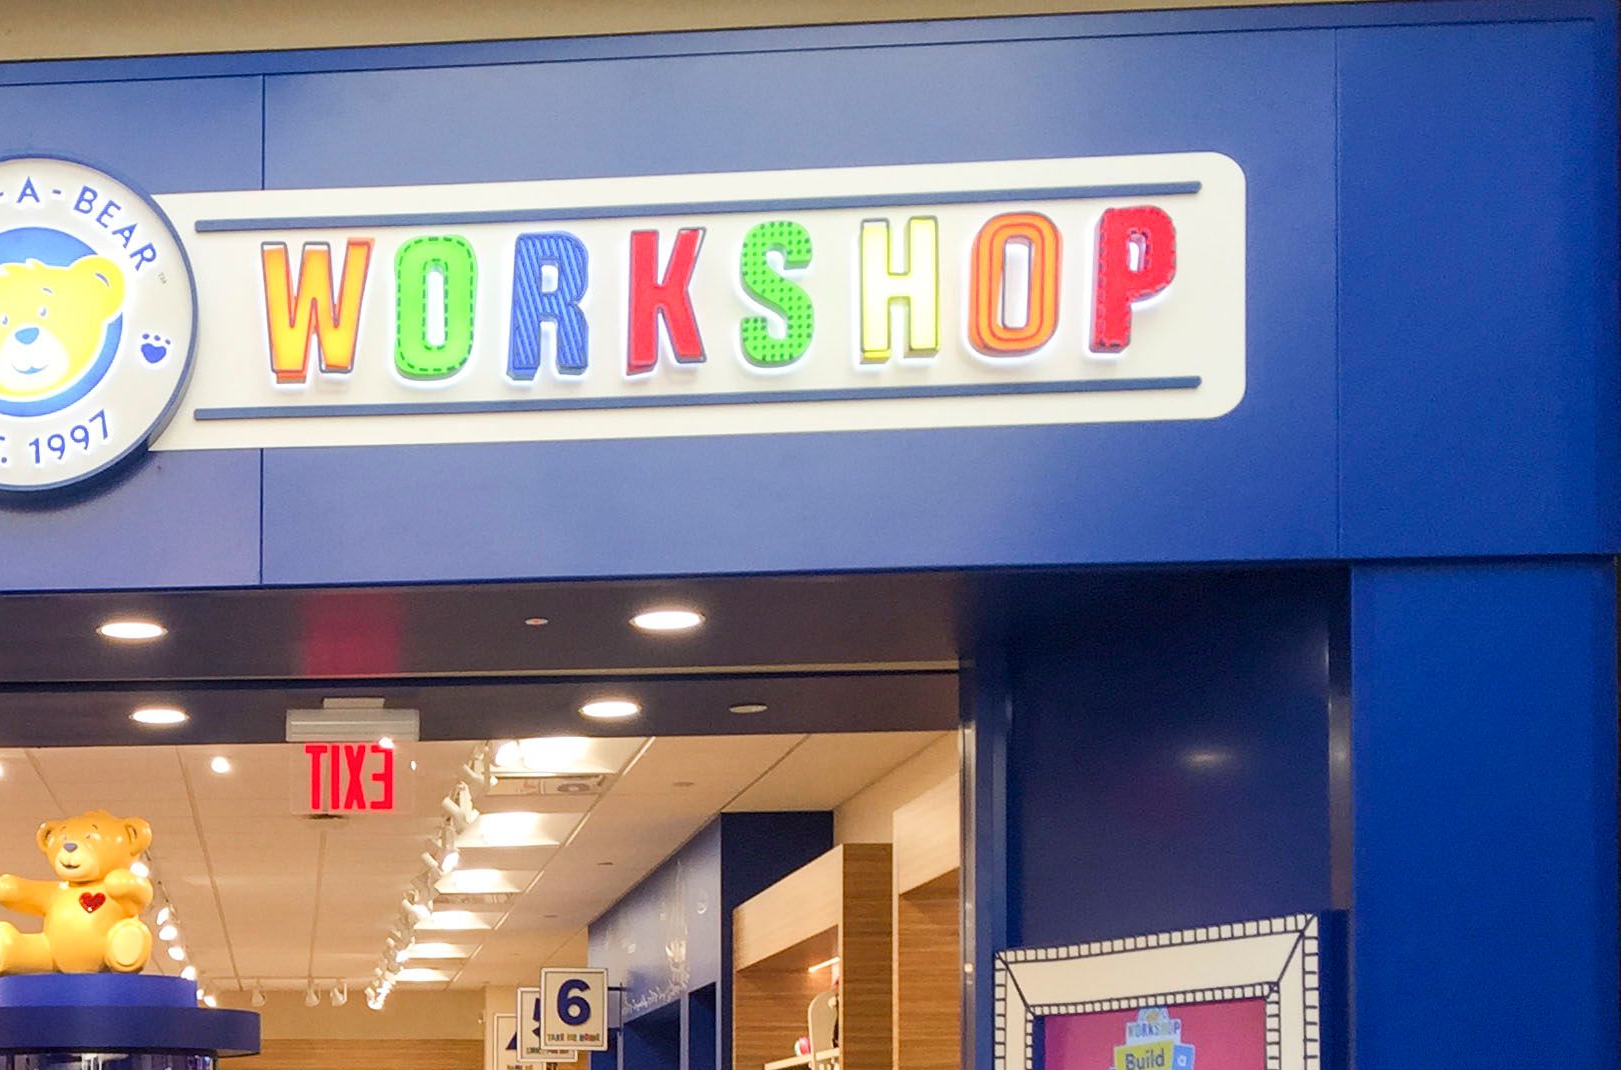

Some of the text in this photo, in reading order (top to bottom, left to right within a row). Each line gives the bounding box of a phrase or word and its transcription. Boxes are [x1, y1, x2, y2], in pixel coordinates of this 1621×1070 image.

[260, 204, 1177, 383] WORKSHOP
[28, 409, 109, 464] 1997
[556, 978, 591, 1027] 6
